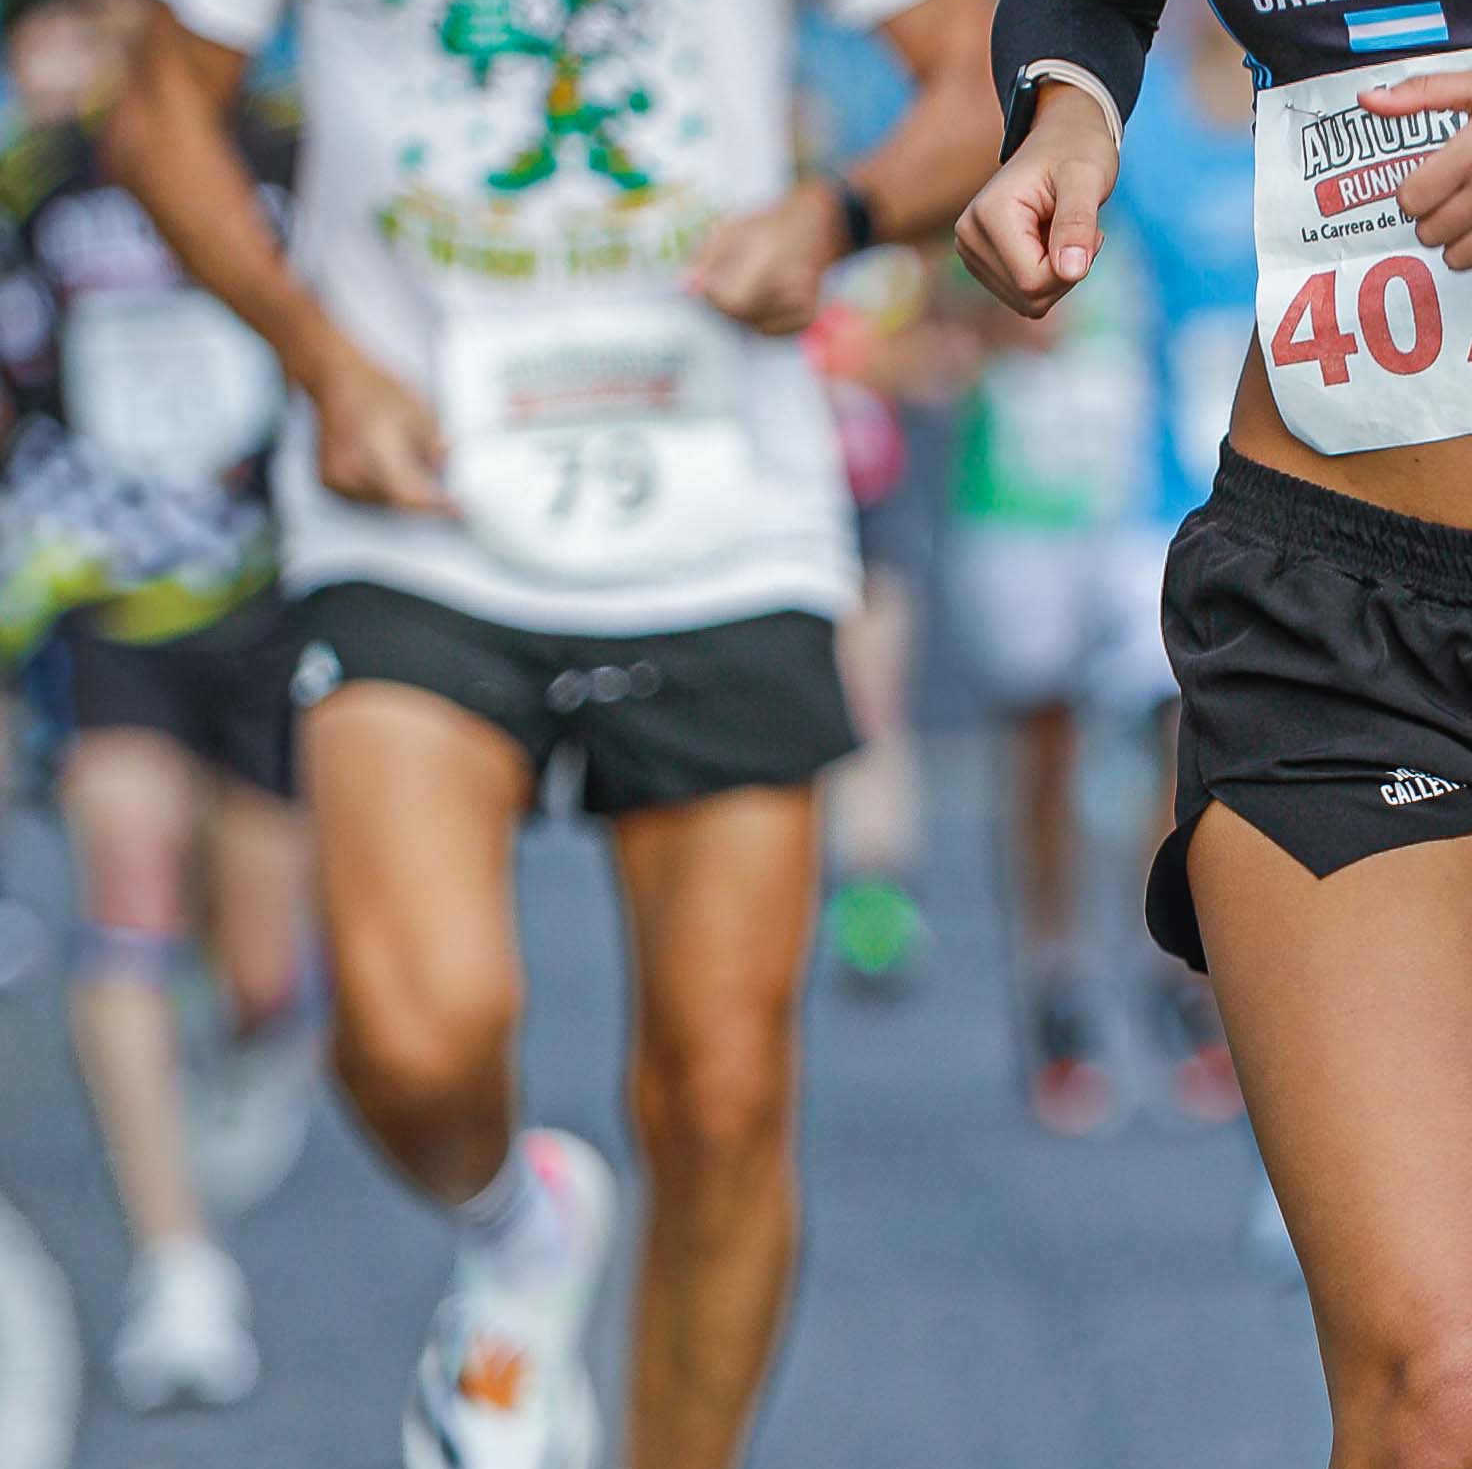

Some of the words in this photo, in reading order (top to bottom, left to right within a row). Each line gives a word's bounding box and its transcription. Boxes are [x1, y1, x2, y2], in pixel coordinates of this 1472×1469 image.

[1301, 225, 1319, 243] La
[1320, 220, 1375, 240] Carrera
[1376, 211, 1397, 229] de
